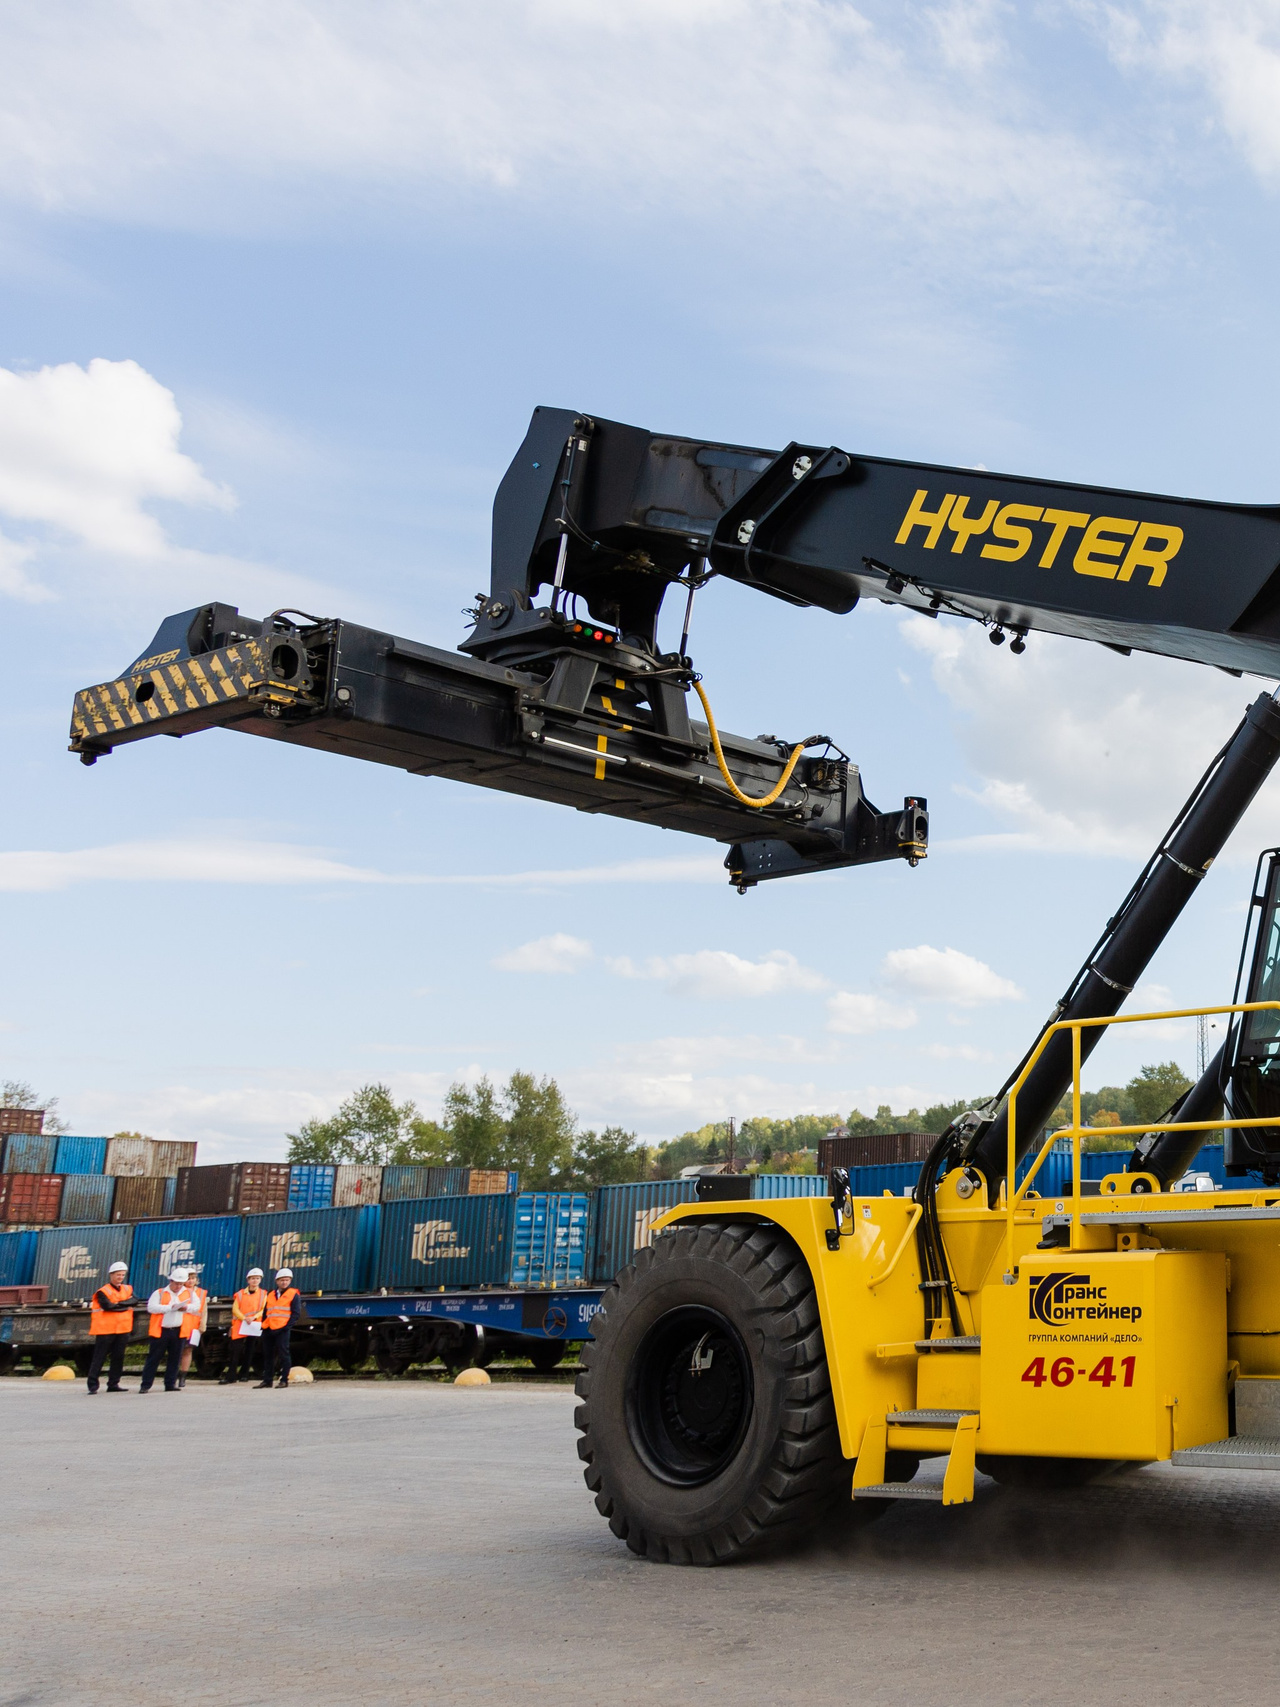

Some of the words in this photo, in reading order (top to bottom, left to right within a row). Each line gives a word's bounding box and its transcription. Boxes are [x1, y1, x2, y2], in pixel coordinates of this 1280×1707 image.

[894, 489, 1184, 587] HYSTER
[131, 649, 181, 673] HYSTER
[415, 1301, 432, 1312] РЖД
[1028, 1334, 1058, 1342] ГРУППА
[1060, 1333, 1108, 1342] КОМПАНИЙ
[1110, 1334, 1142, 1343] «ДЕЛО»
[1021, 1356, 1136, 1387] 46-41
